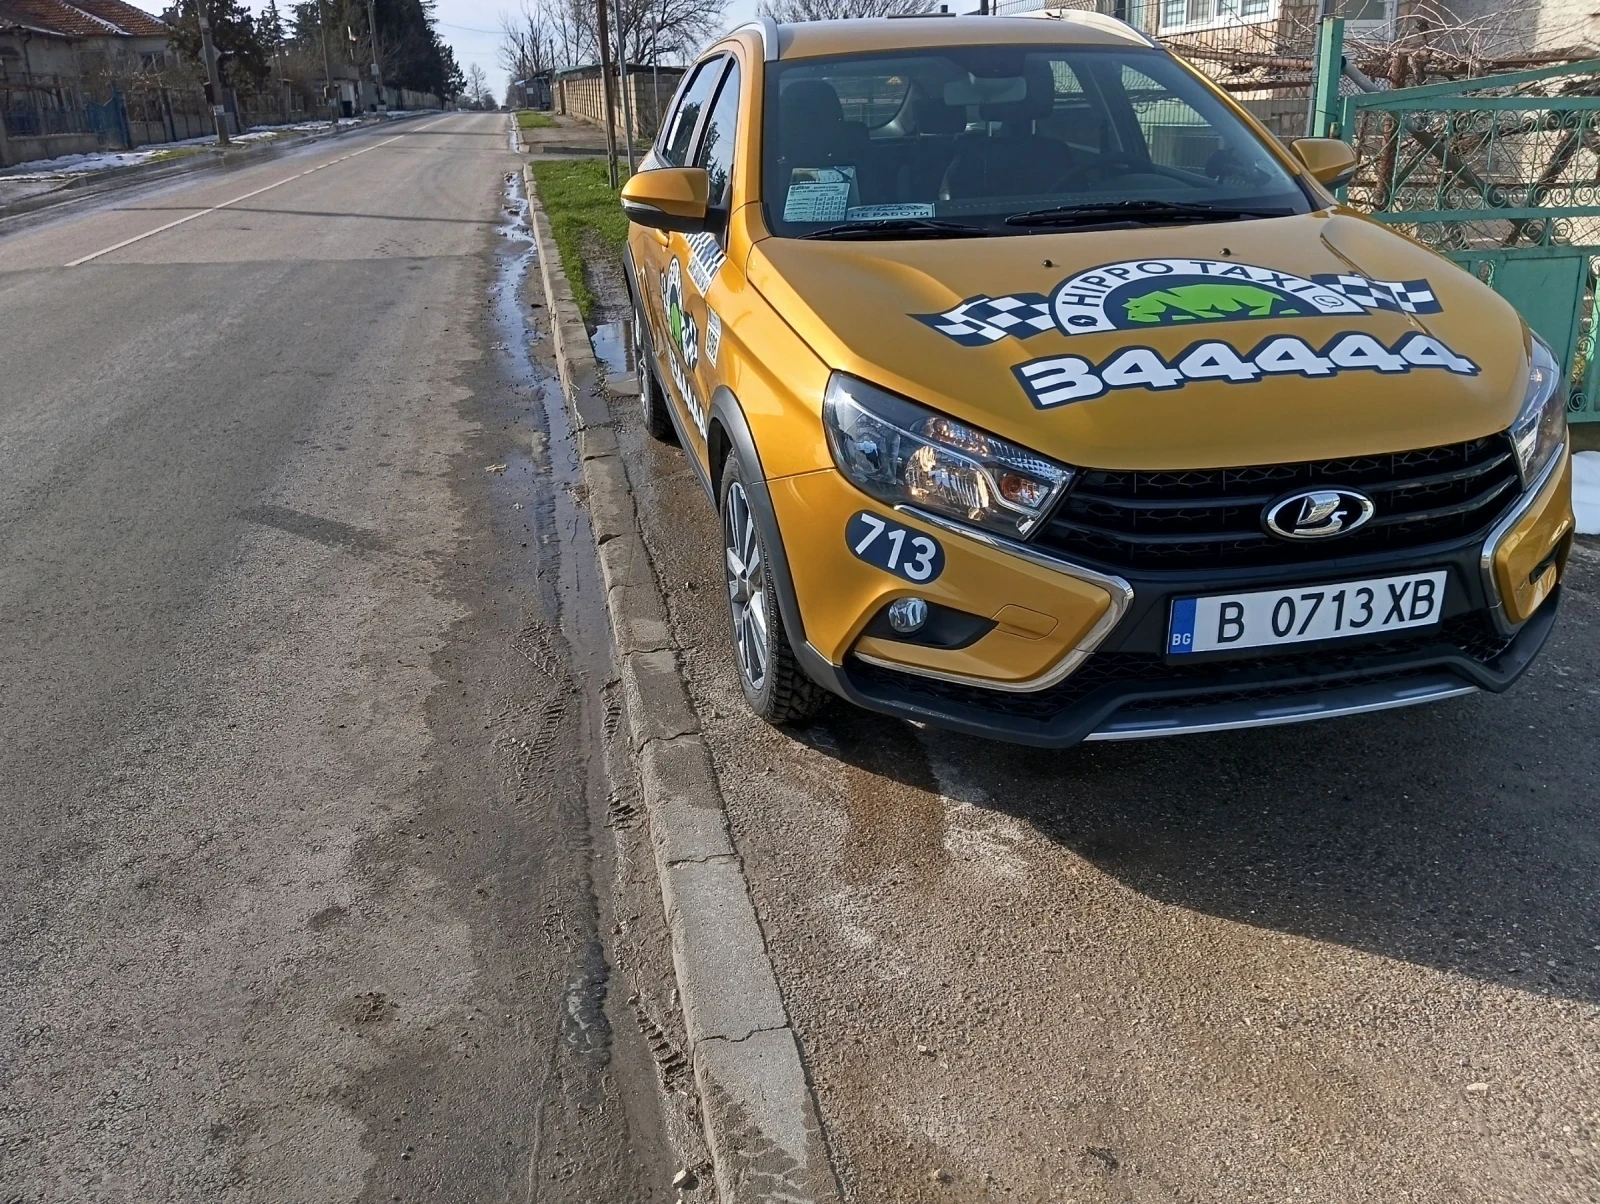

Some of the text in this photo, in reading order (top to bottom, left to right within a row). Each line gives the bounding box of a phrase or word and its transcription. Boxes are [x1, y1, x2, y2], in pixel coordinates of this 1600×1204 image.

[1062, 261, 1315, 308] HIPPO TAXI
[1018, 333, 1474, 406] 344444
[855, 512, 937, 581] 713
[1171, 632, 1192, 646] BG
[1217, 601, 1245, 643] B
